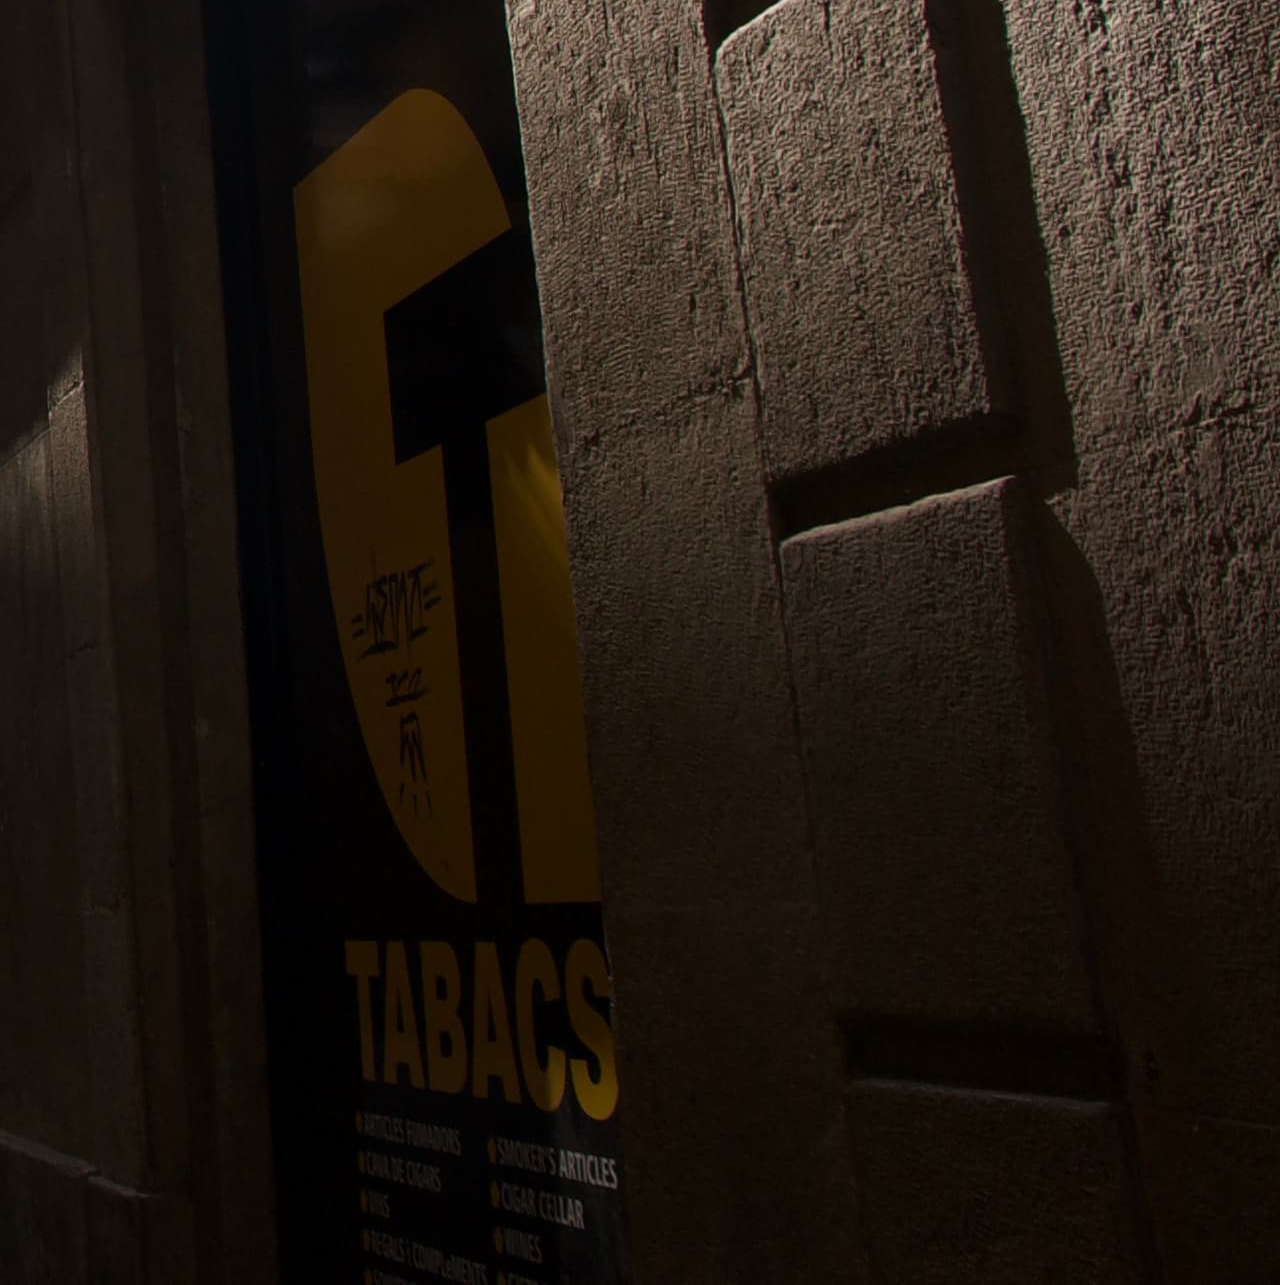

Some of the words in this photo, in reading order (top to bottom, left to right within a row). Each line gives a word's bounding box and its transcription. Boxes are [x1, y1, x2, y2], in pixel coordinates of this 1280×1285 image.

[344, 937, 620, 1122] TABACS
[497, 1137, 557, 1177] SMOKER'S
[559, 1148, 618, 1190] ARTICLES
[501, 1181, 537, 1217] CIGAR
[538, 1191, 585, 1230] CELLAR
[504, 1226, 543, 1265] WINES
